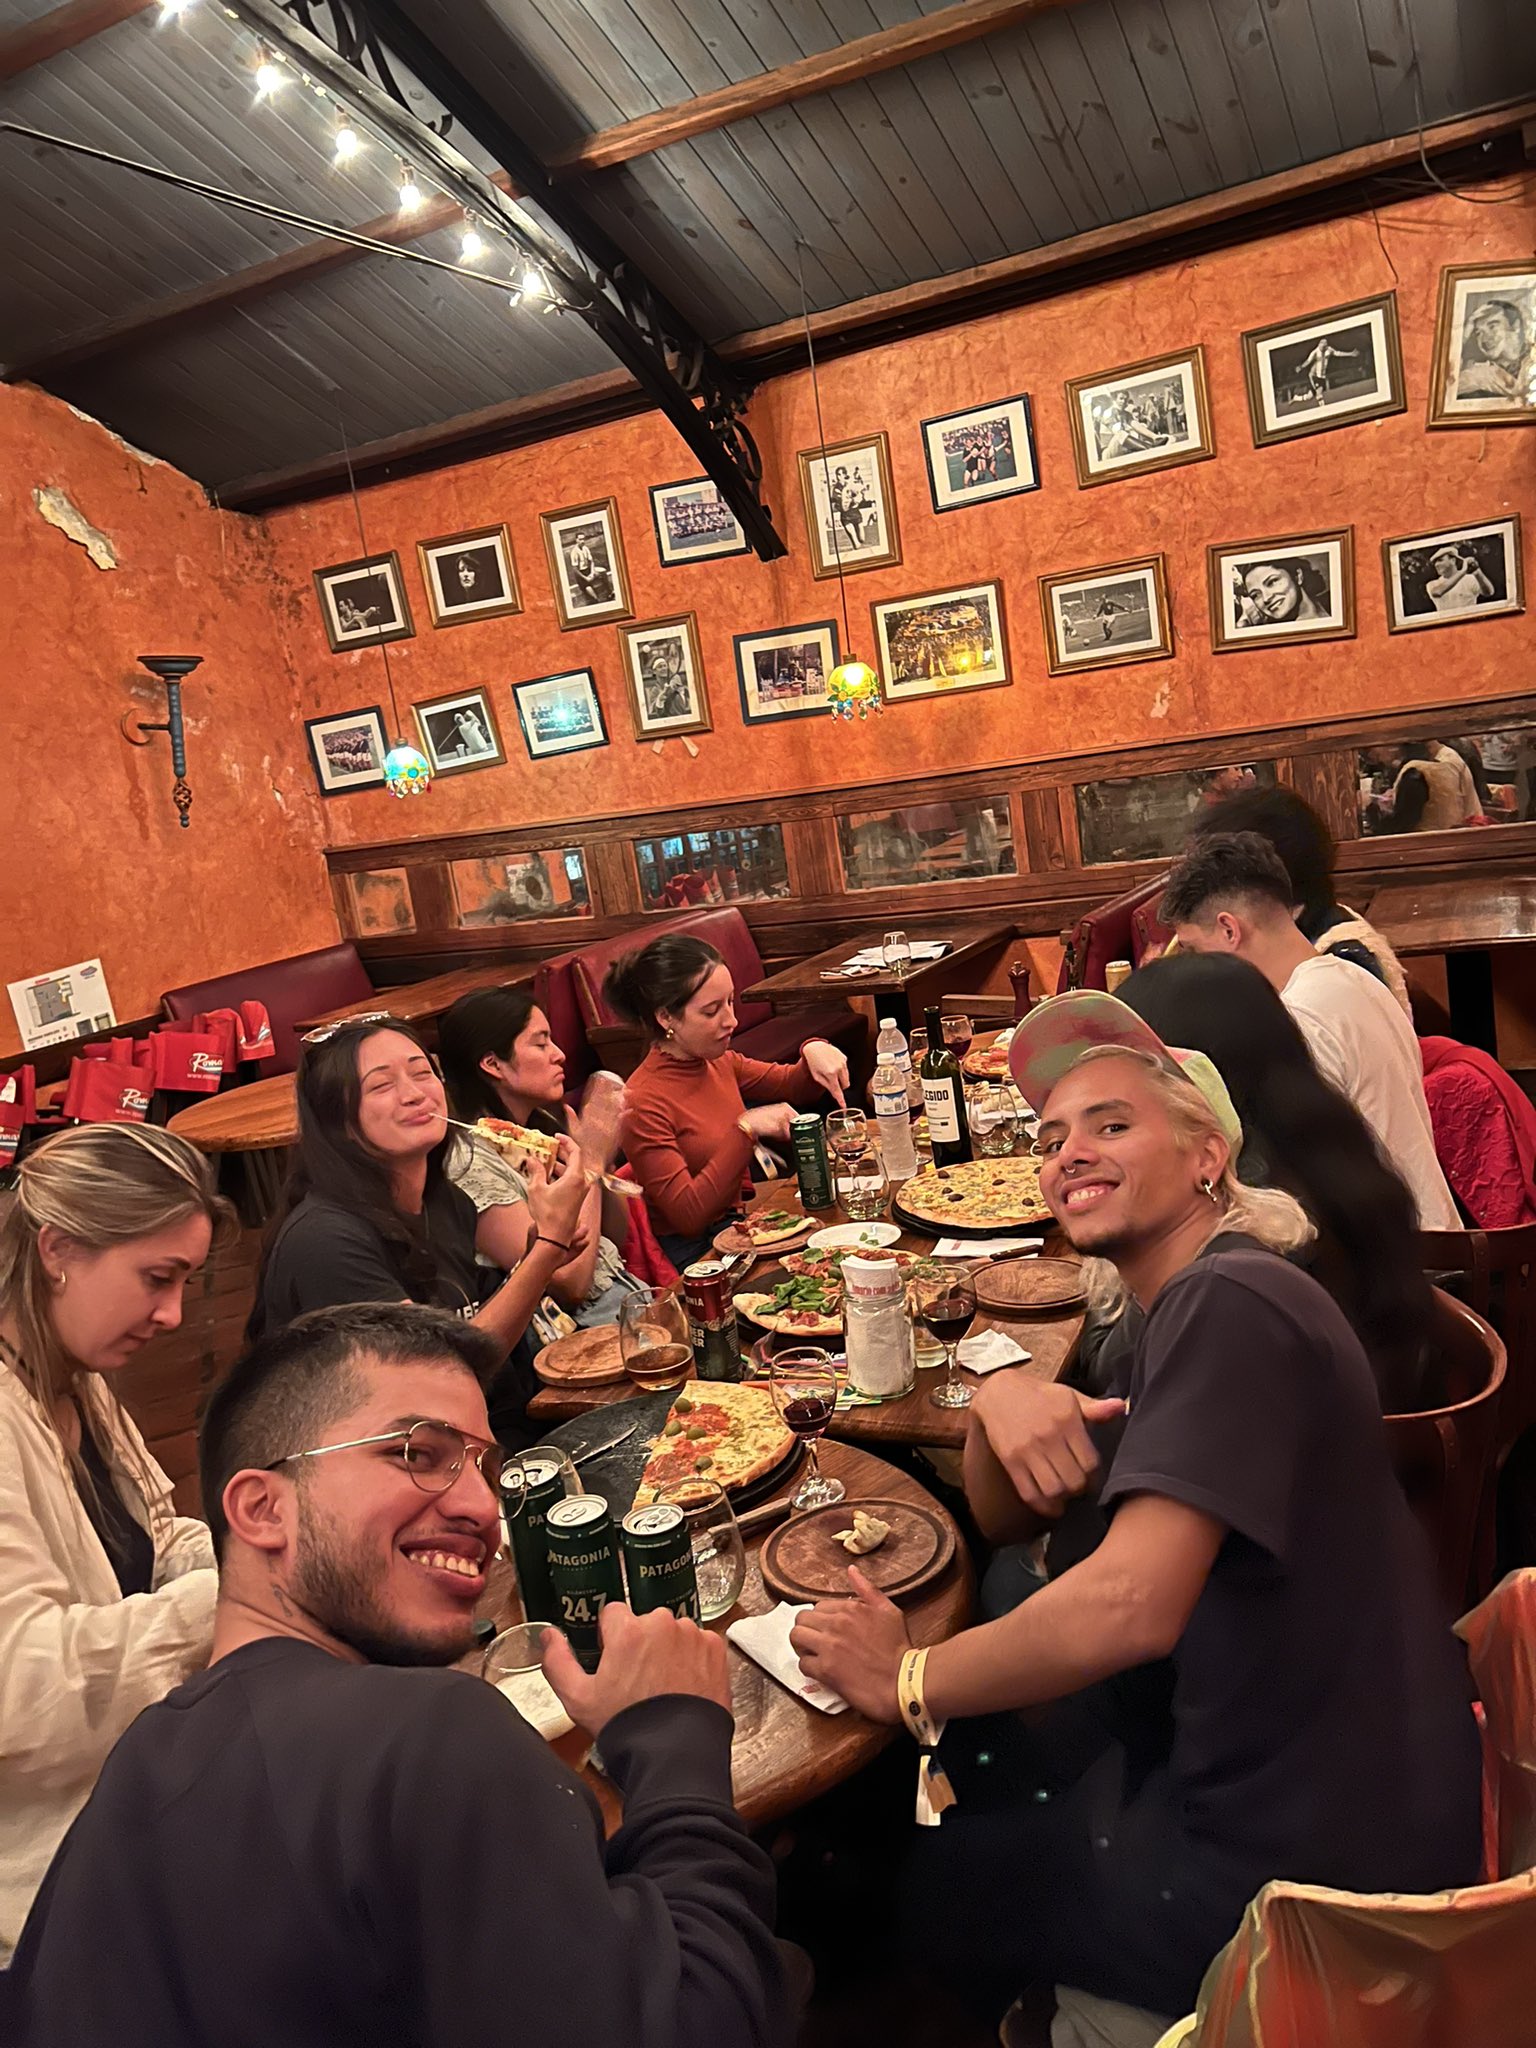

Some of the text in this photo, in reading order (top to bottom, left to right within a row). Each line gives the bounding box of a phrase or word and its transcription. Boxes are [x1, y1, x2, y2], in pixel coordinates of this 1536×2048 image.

[527, 1512, 548, 1528] PA
[547, 1545, 611, 1567] PATAGONIA
[561, 1592, 608, 1623] 24.7
